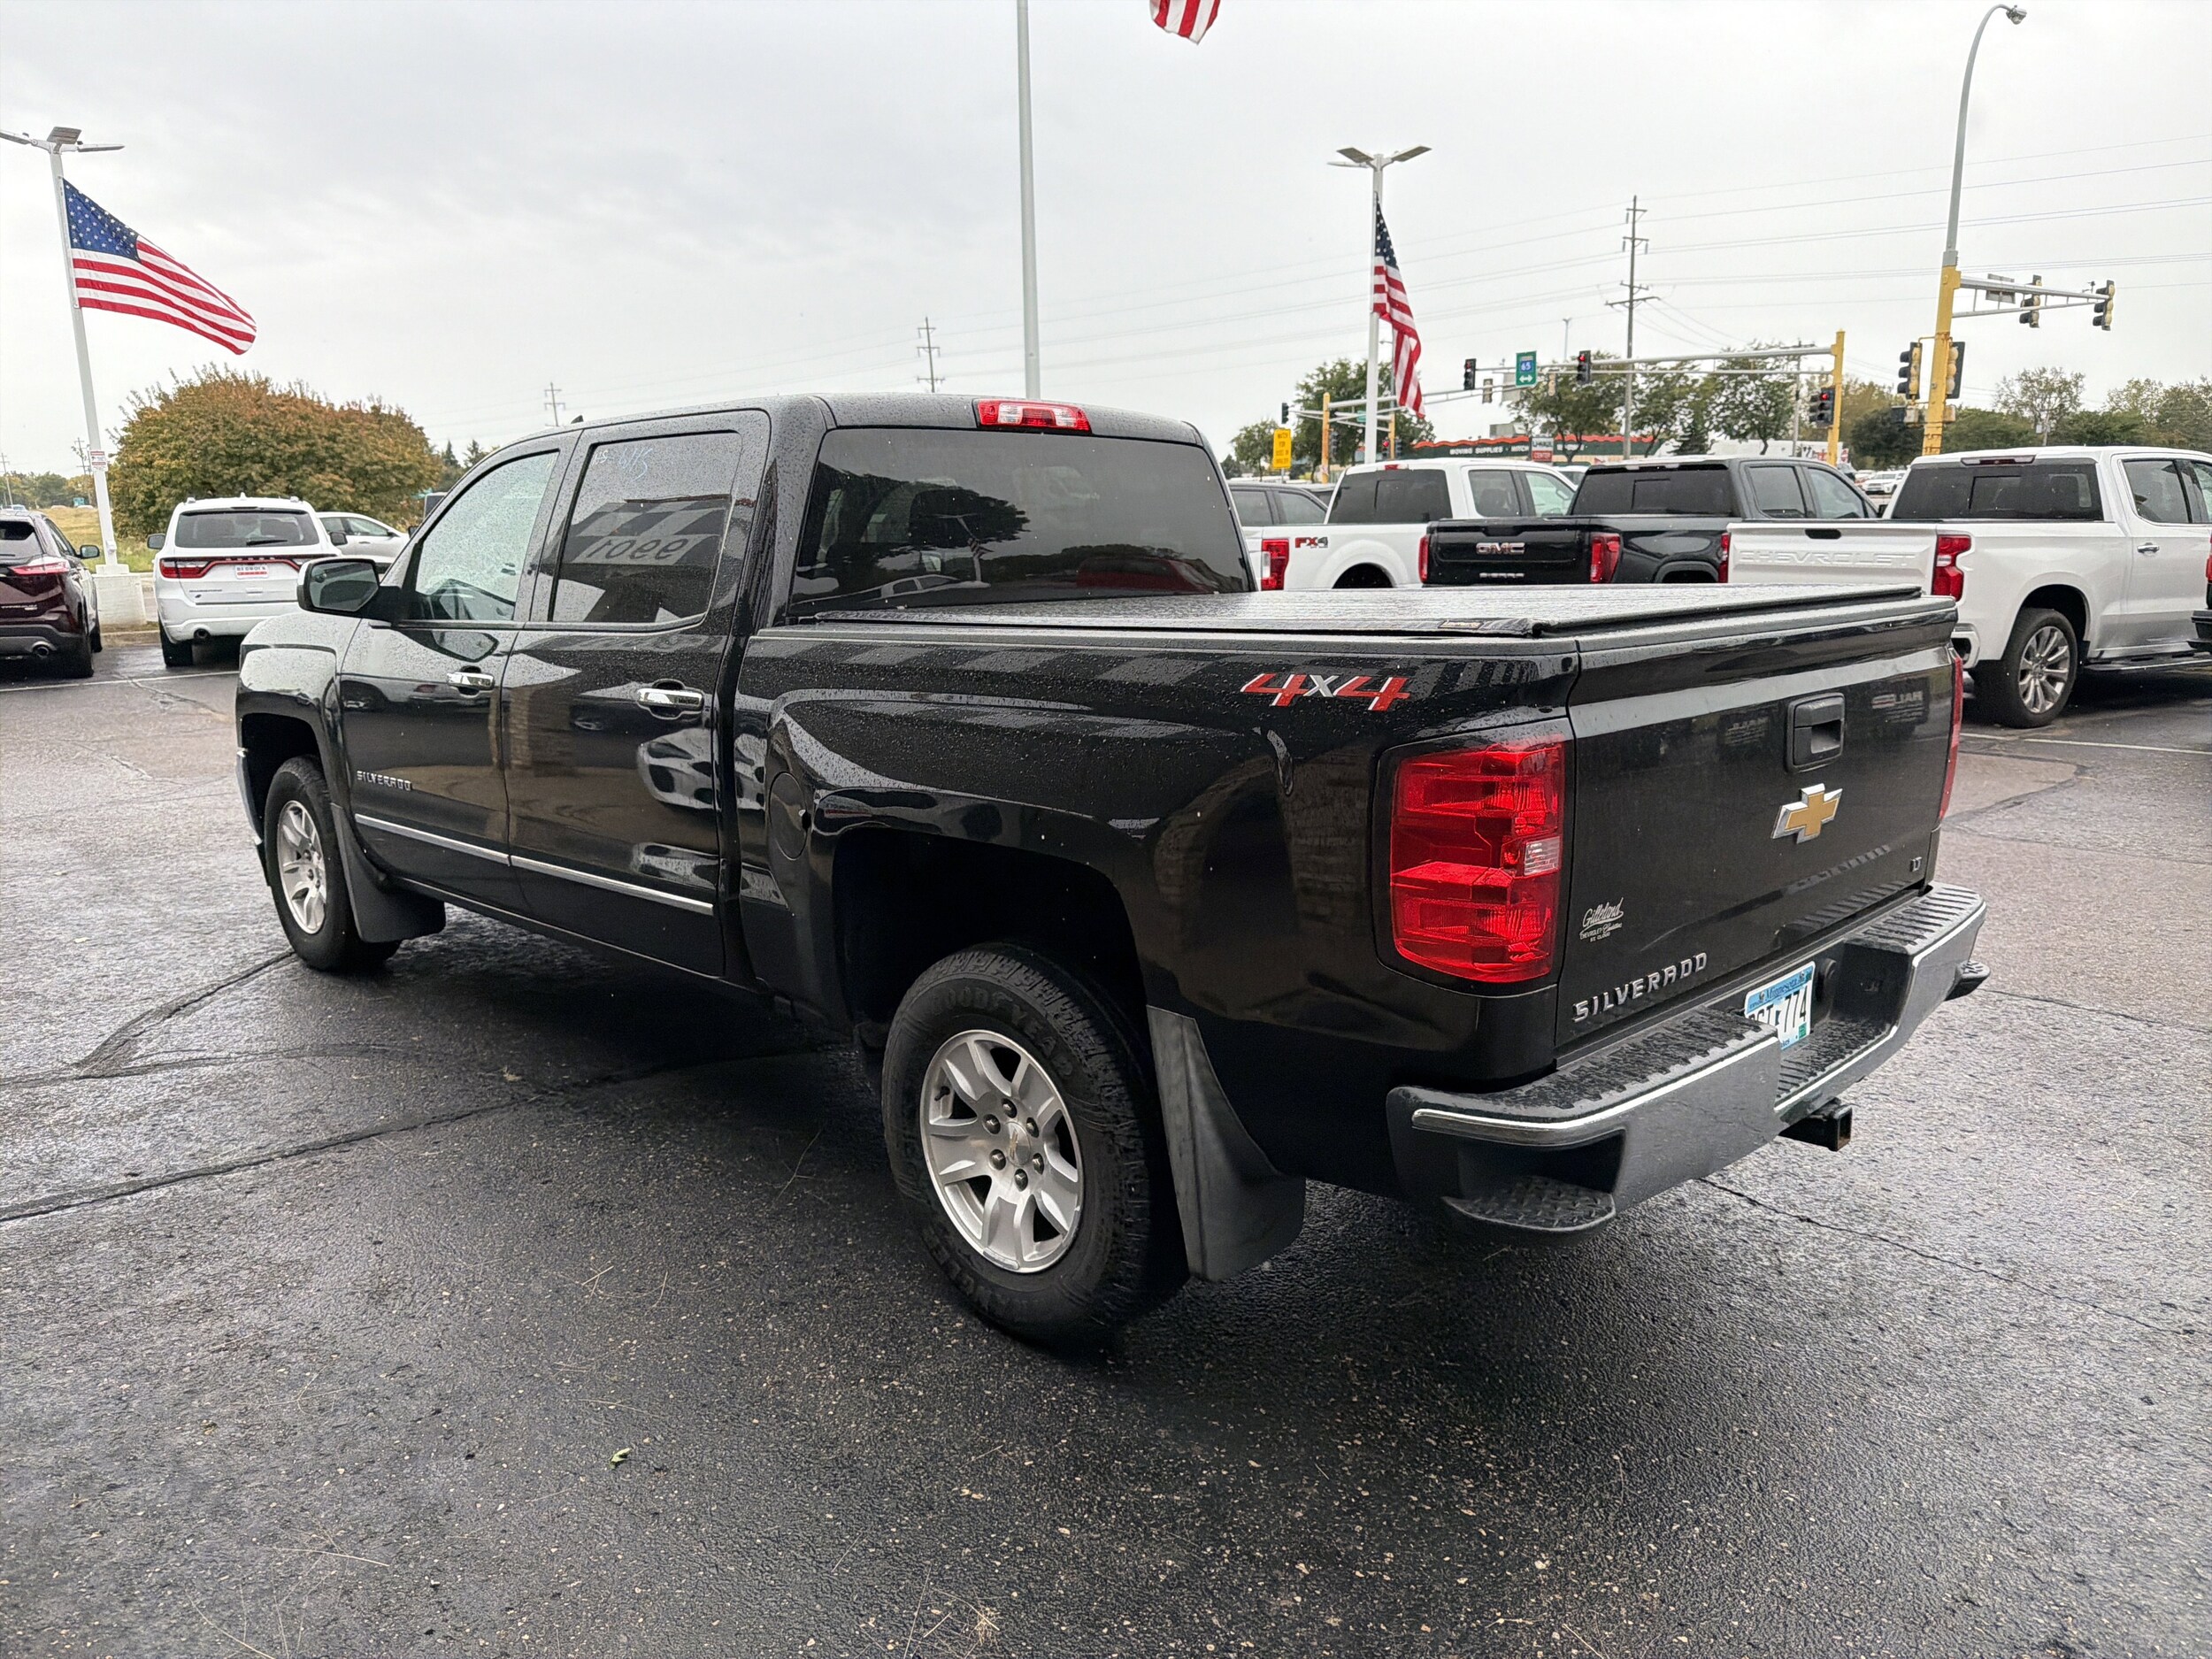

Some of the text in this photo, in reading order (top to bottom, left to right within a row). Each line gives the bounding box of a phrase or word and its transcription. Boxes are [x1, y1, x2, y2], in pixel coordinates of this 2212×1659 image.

[1475, 446, 1503, 455] SUPPLIES
[1295, 536, 1328, 549] FX4
[1476, 541, 1525, 555] GMC
[1739, 550, 1916, 566] CHEVROLET
[357, 770, 411, 791] SILVERADO
[1571, 952, 1708, 1023] SILVERADO
